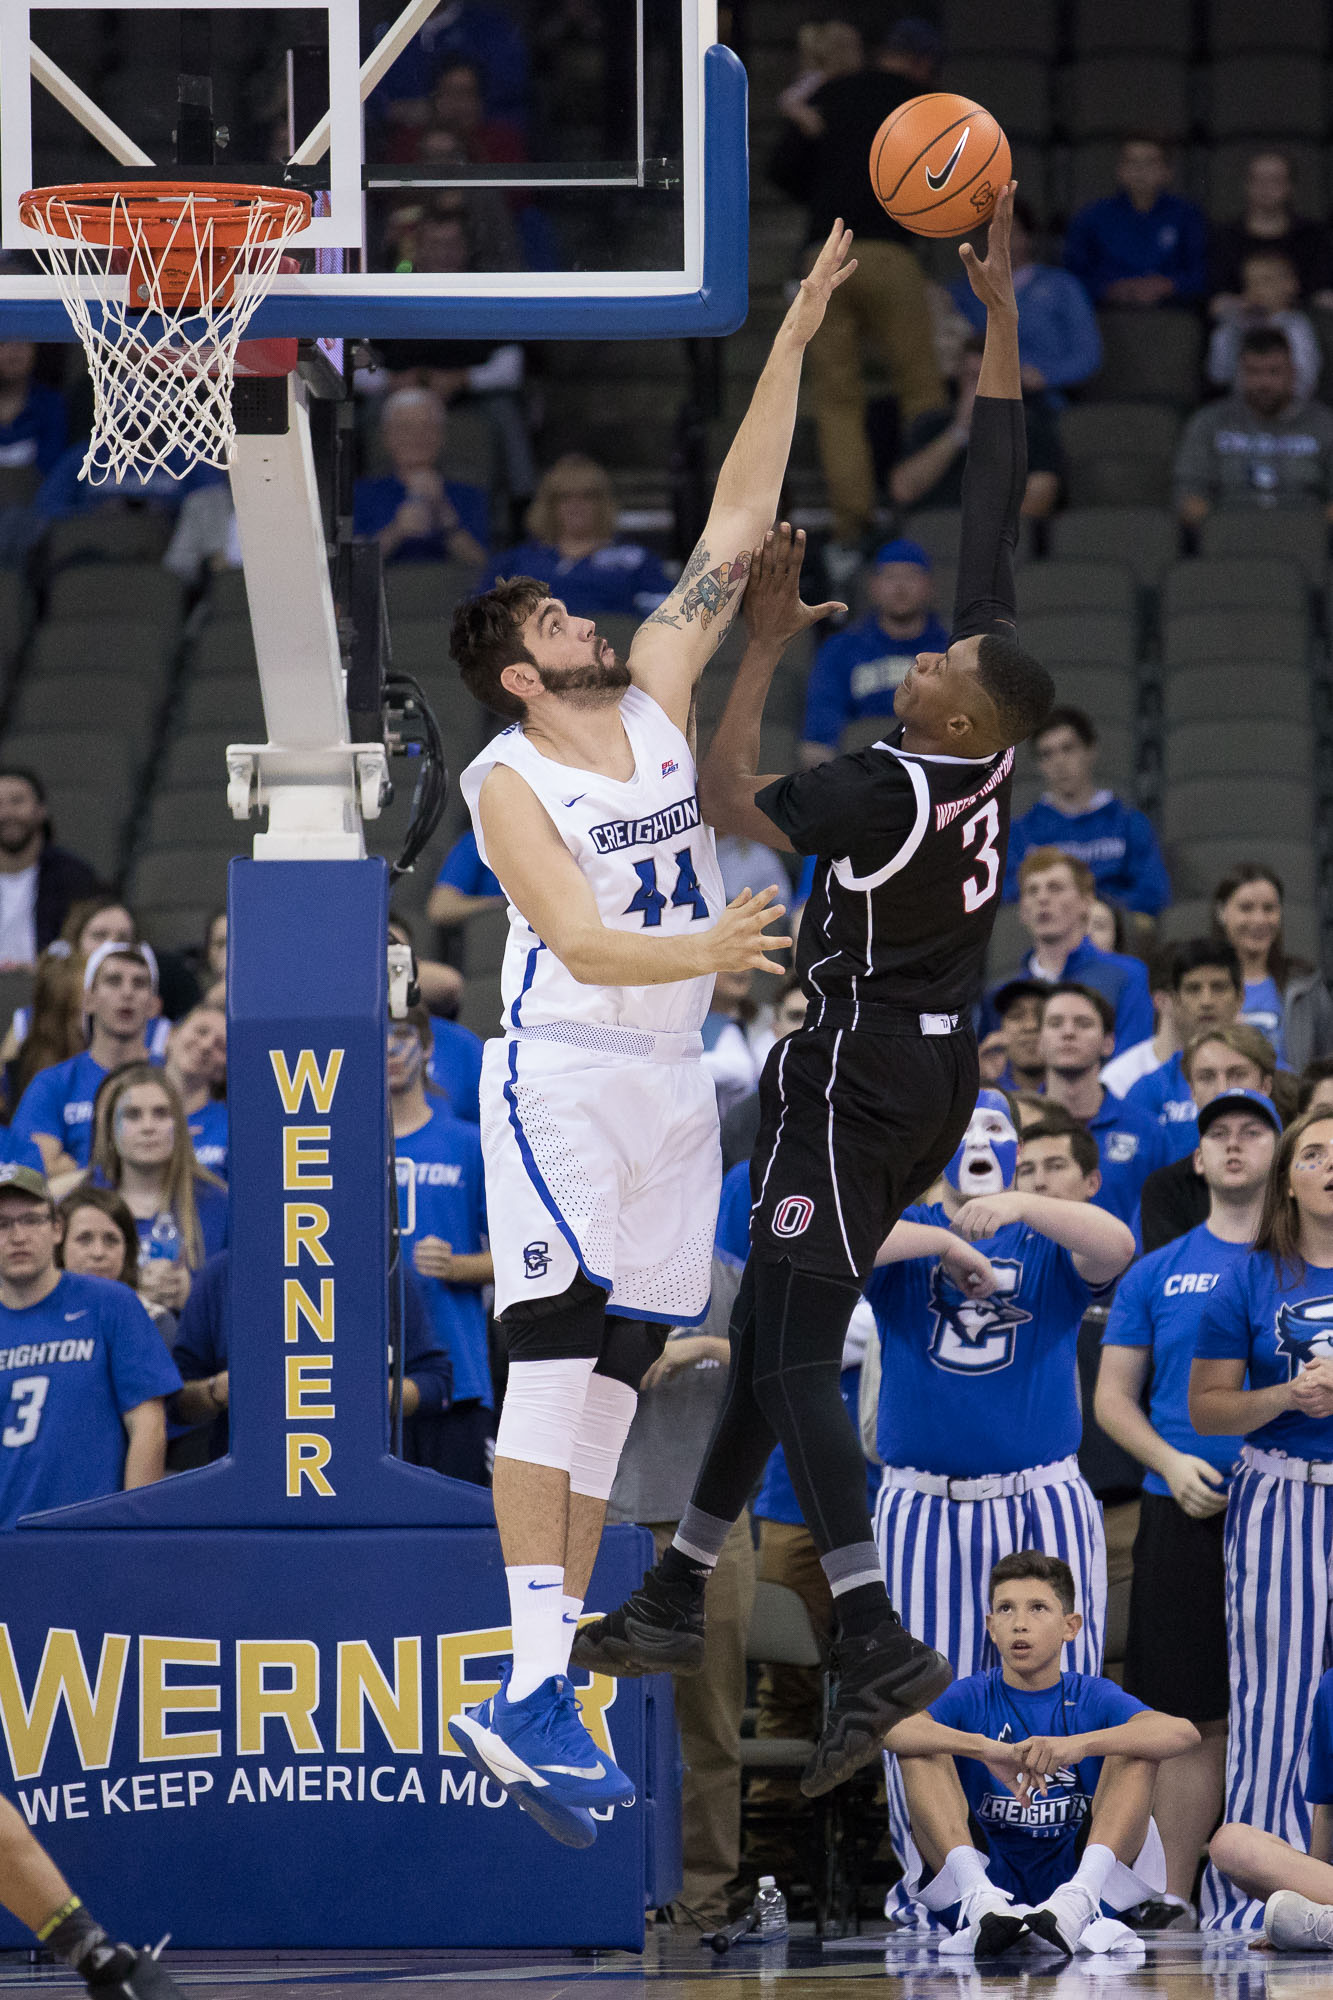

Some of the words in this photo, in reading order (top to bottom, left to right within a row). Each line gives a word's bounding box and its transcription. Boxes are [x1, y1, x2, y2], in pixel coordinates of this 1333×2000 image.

[589, 796, 700, 854] CREIGHTON
[962, 797, 1000, 914] 3
[620, 847, 710, 928] 44
[268, 1049, 345, 1498] WERNER
[2, 1376, 50, 1448] 3
[18, 1782, 90, 1826] WE
[101, 1770, 214, 1815] KEEP
[227, 1766, 426, 1804] AMERICA
